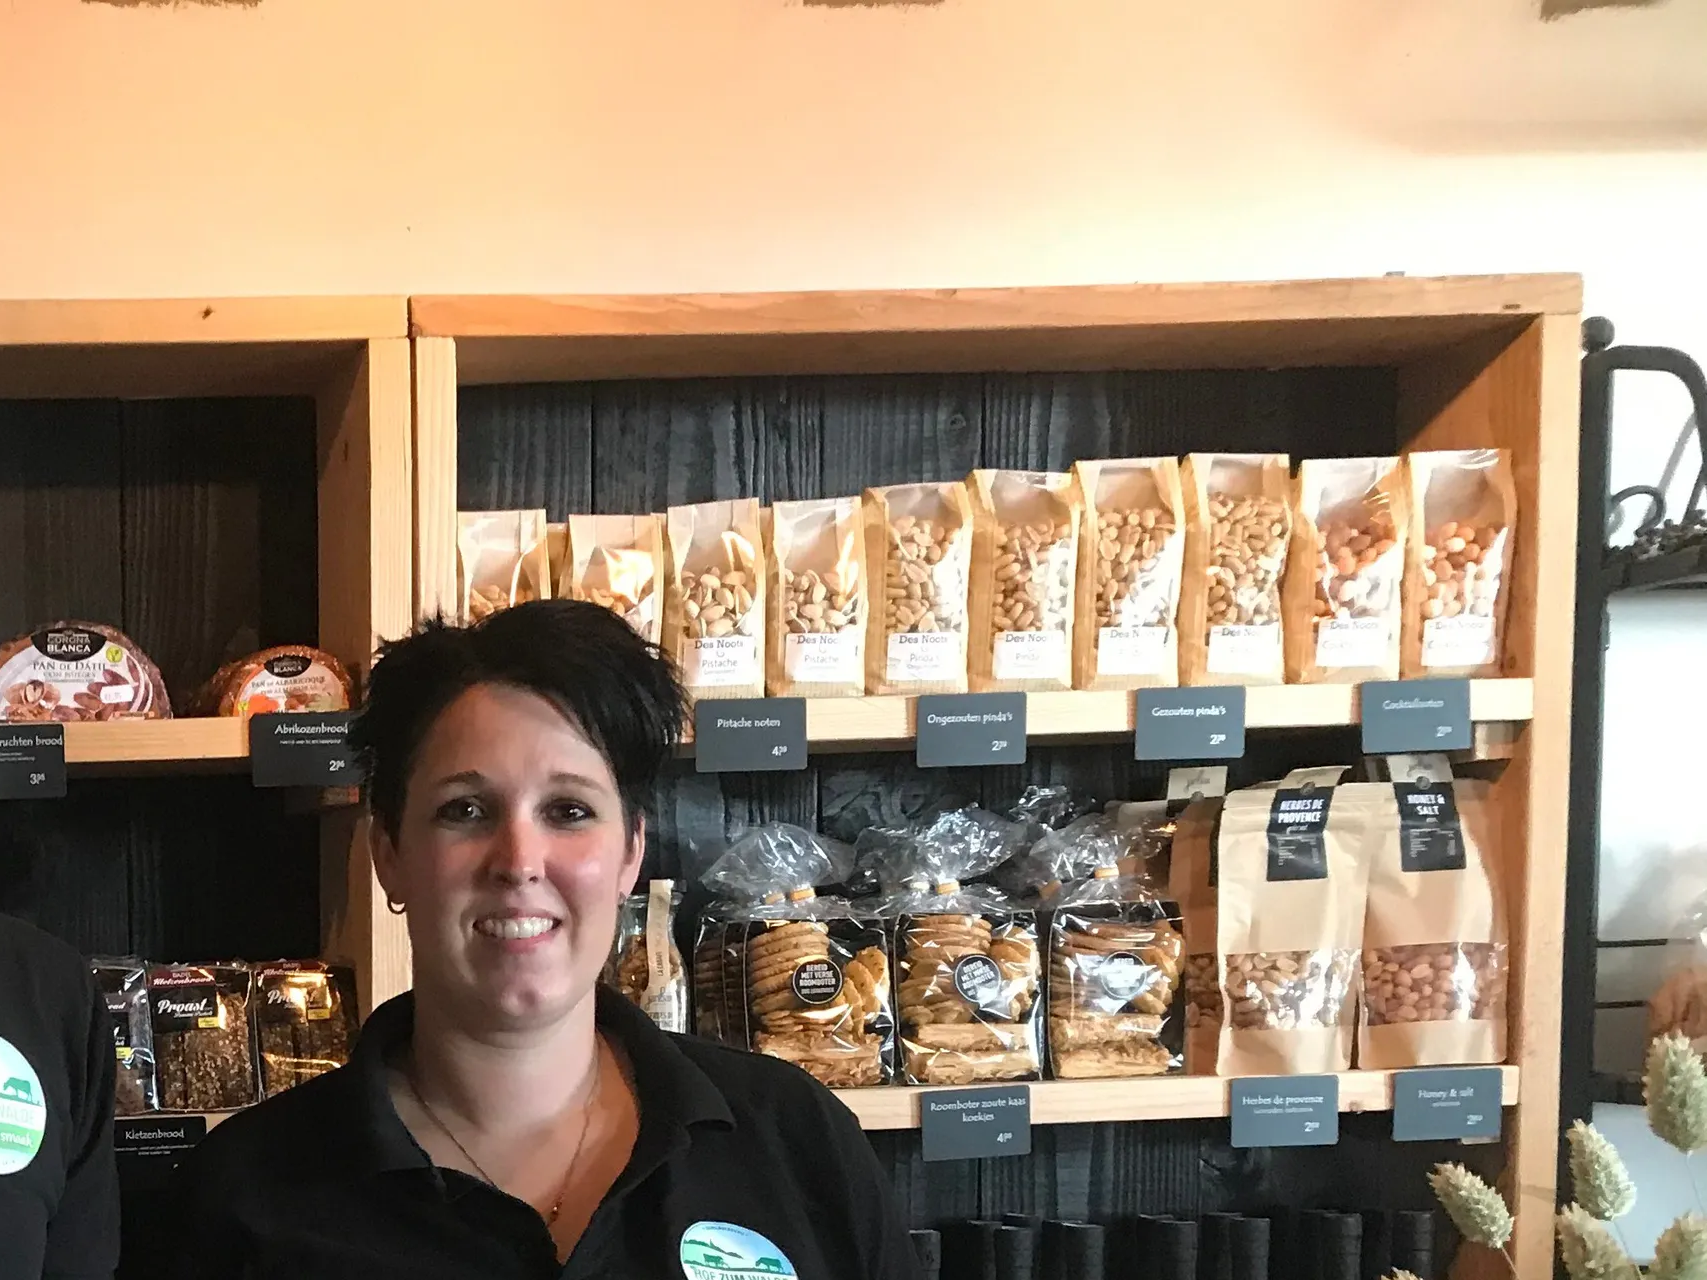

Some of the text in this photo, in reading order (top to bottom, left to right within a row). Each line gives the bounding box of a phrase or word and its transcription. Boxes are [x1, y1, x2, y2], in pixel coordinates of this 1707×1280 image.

[796, 635, 817, 645] Des
[899, 634, 919, 644] Des
[1005, 633, 1025, 643] Des
[47, 644, 91, 653] BLANCA
[694, 640, 714, 650] Des
[702, 658, 738, 668] Pistache
[804, 654, 839, 664] Pistache
[33, 662, 55, 670] PAN
[1152, 705, 1226, 718] Gezouten pinda's
[717, 717, 781, 729] Pistache noten
[927, 711, 1013, 725] Ongezouten pinda's
[274, 722, 348, 735] Abrikozenbrood
[35, 735, 63, 747] brood
[1280, 798, 1325, 811] HERBES DE
[1416, 805, 1440, 815] SALT
[1278, 811, 1322, 823] PROVENCE
[801, 970, 834, 979] MET VERSE
[799, 978, 836, 987] ROOMBOTER
[157, 998, 208, 1014] Proast
[1418, 1088, 1447, 1099] Honey
[1449, 1087, 1457, 1097] &
[931, 1097, 1026, 1111] Roomboter zoute kaas
[1242, 1095, 1324, 1106] Herbes de provence
[962, 1112, 994, 1122] koekjes
[125, 1128, 185, 1139] Kletzenbrood
[0, 1131, 34, 1148] smaak
